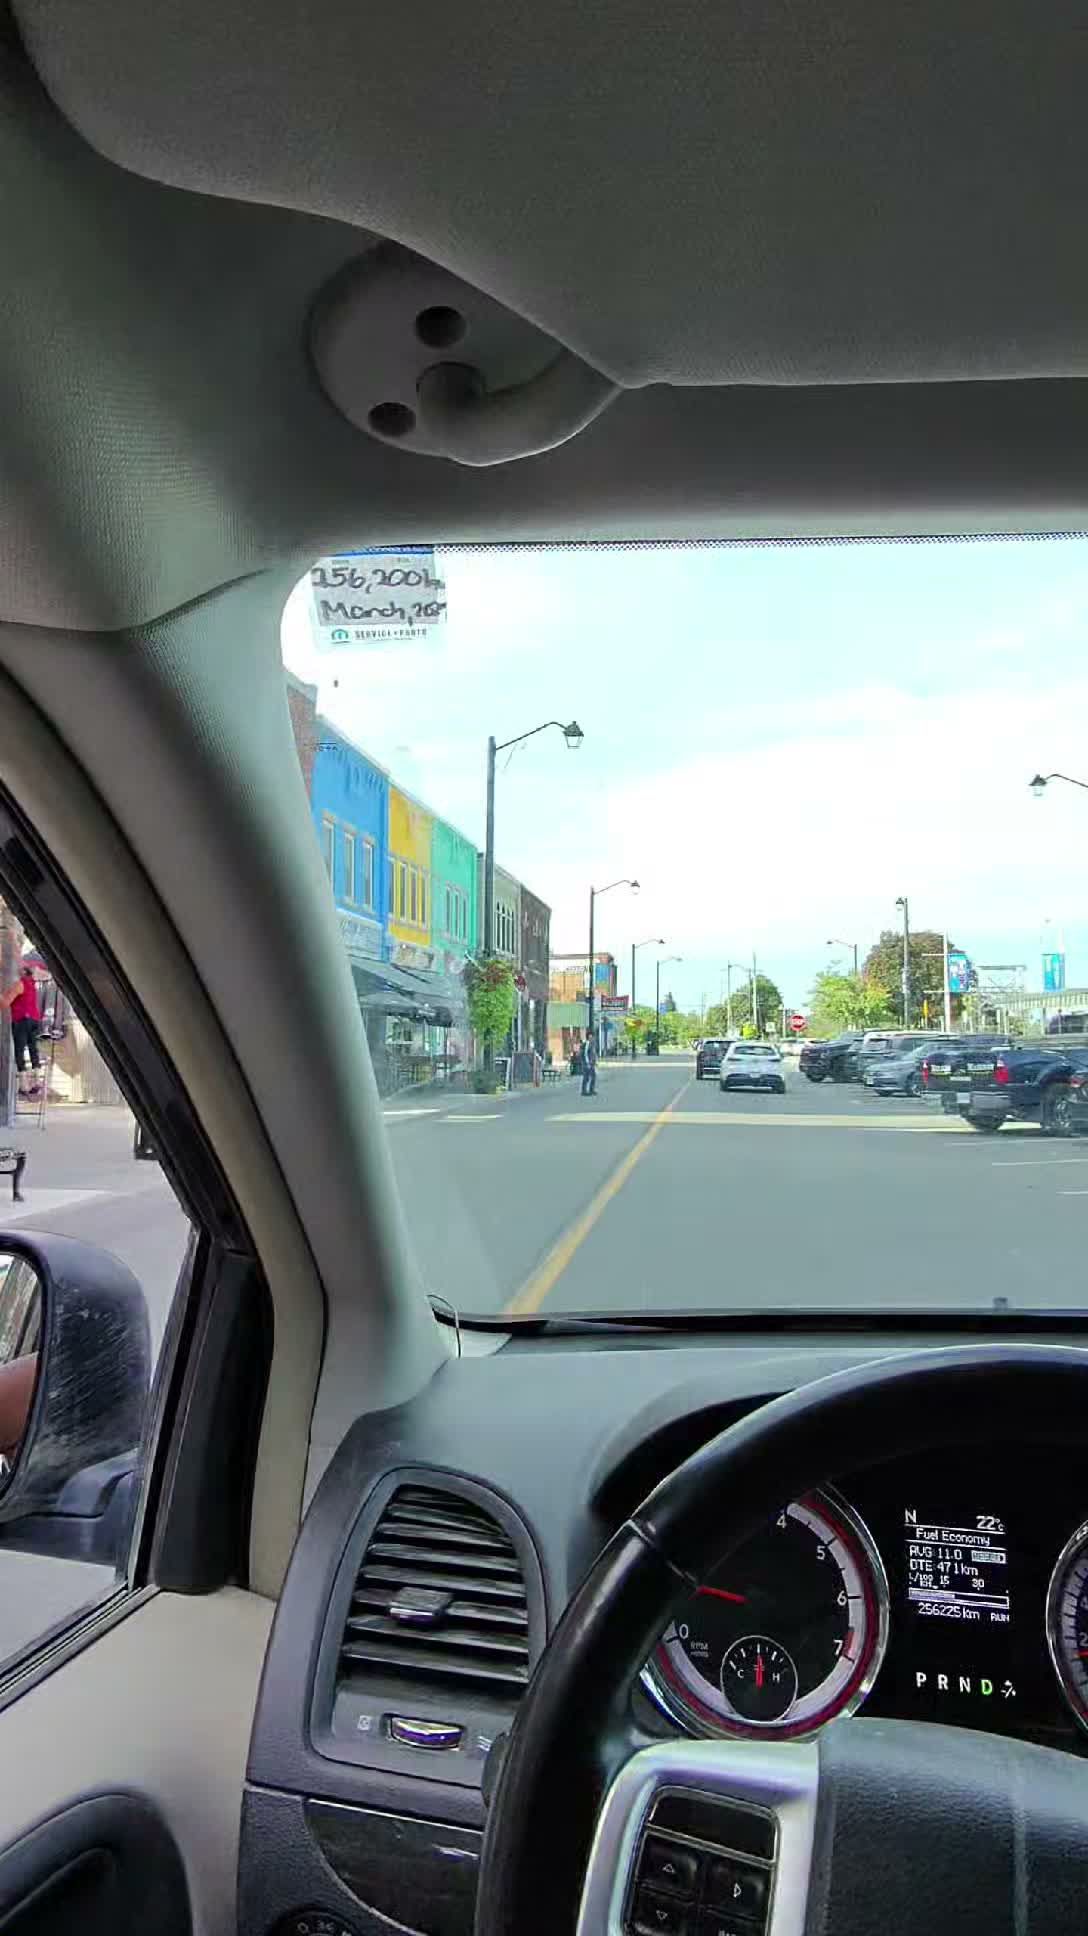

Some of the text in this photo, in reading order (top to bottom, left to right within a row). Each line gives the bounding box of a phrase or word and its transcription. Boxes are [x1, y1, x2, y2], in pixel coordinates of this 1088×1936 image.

[776, 1515, 787, 1528] 4
[904, 1508, 917, 1524] N
[916, 1527, 991, 1547] Fuel Economy
[816, 1545, 826, 1560] 5
[937, 1547, 963, 1560] 11.0
[909, 1558, 933, 1572] DTE
[837, 1590, 847, 1606] 6
[679, 1623, 689, 1640] 0
[833, 1640, 844, 1656] 7
[736, 1668, 781, 1684] C H
[915, 1672, 993, 1695] P R N D
